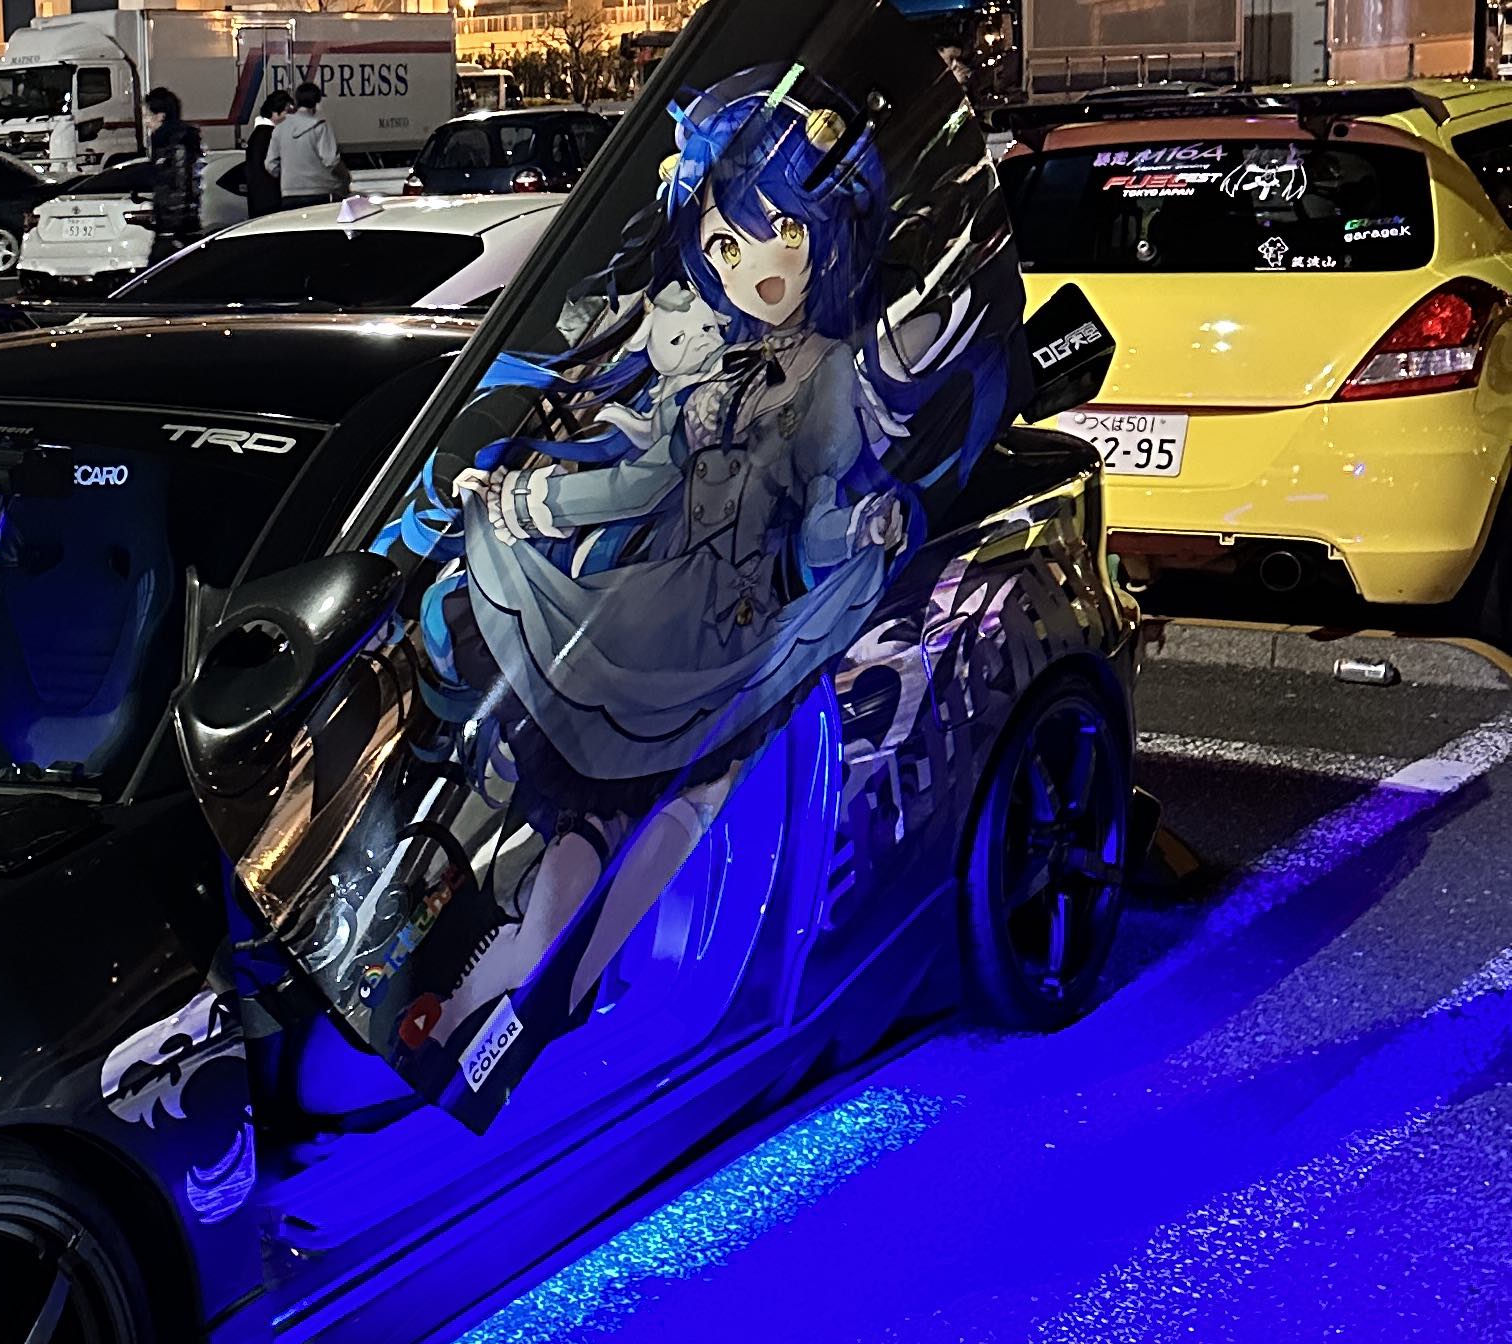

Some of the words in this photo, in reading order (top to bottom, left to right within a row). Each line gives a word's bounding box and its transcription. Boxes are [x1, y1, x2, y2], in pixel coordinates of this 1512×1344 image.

[273, 64, 409, 98] EXPRESS
[161, 424, 297, 453] TRD
[1086, 416, 1156, 433] つくば501
[1090, 436, 1176, 470] 2-95
[73, 465, 129, 485] CARO
[467, 1031, 496, 1074] ANY
[471, 1020, 520, 1084] COLOR
